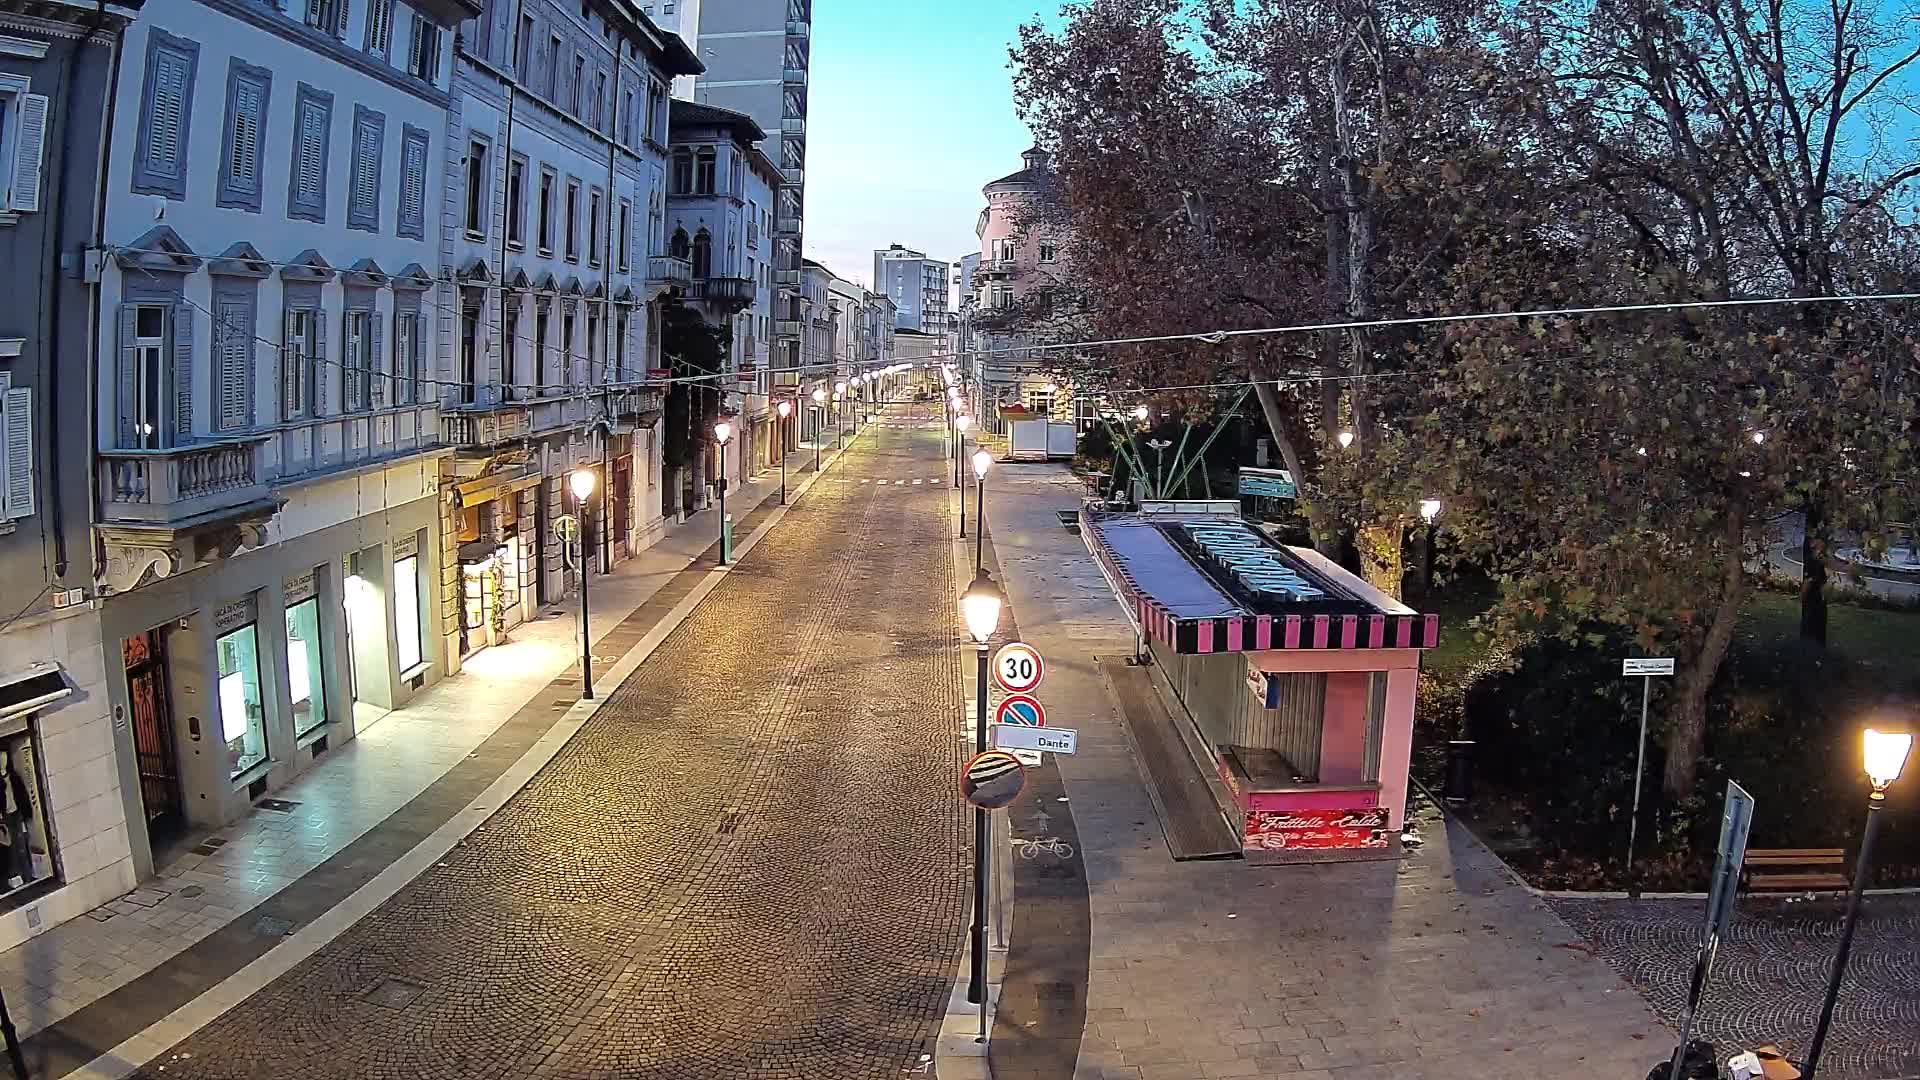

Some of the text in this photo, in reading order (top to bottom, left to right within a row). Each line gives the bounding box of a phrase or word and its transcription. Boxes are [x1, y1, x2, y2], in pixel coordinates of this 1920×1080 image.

[1006, 658, 1032, 679] 30
[1038, 737, 1069, 749] Dante
[1330, 815, 1381, 827] Calde
